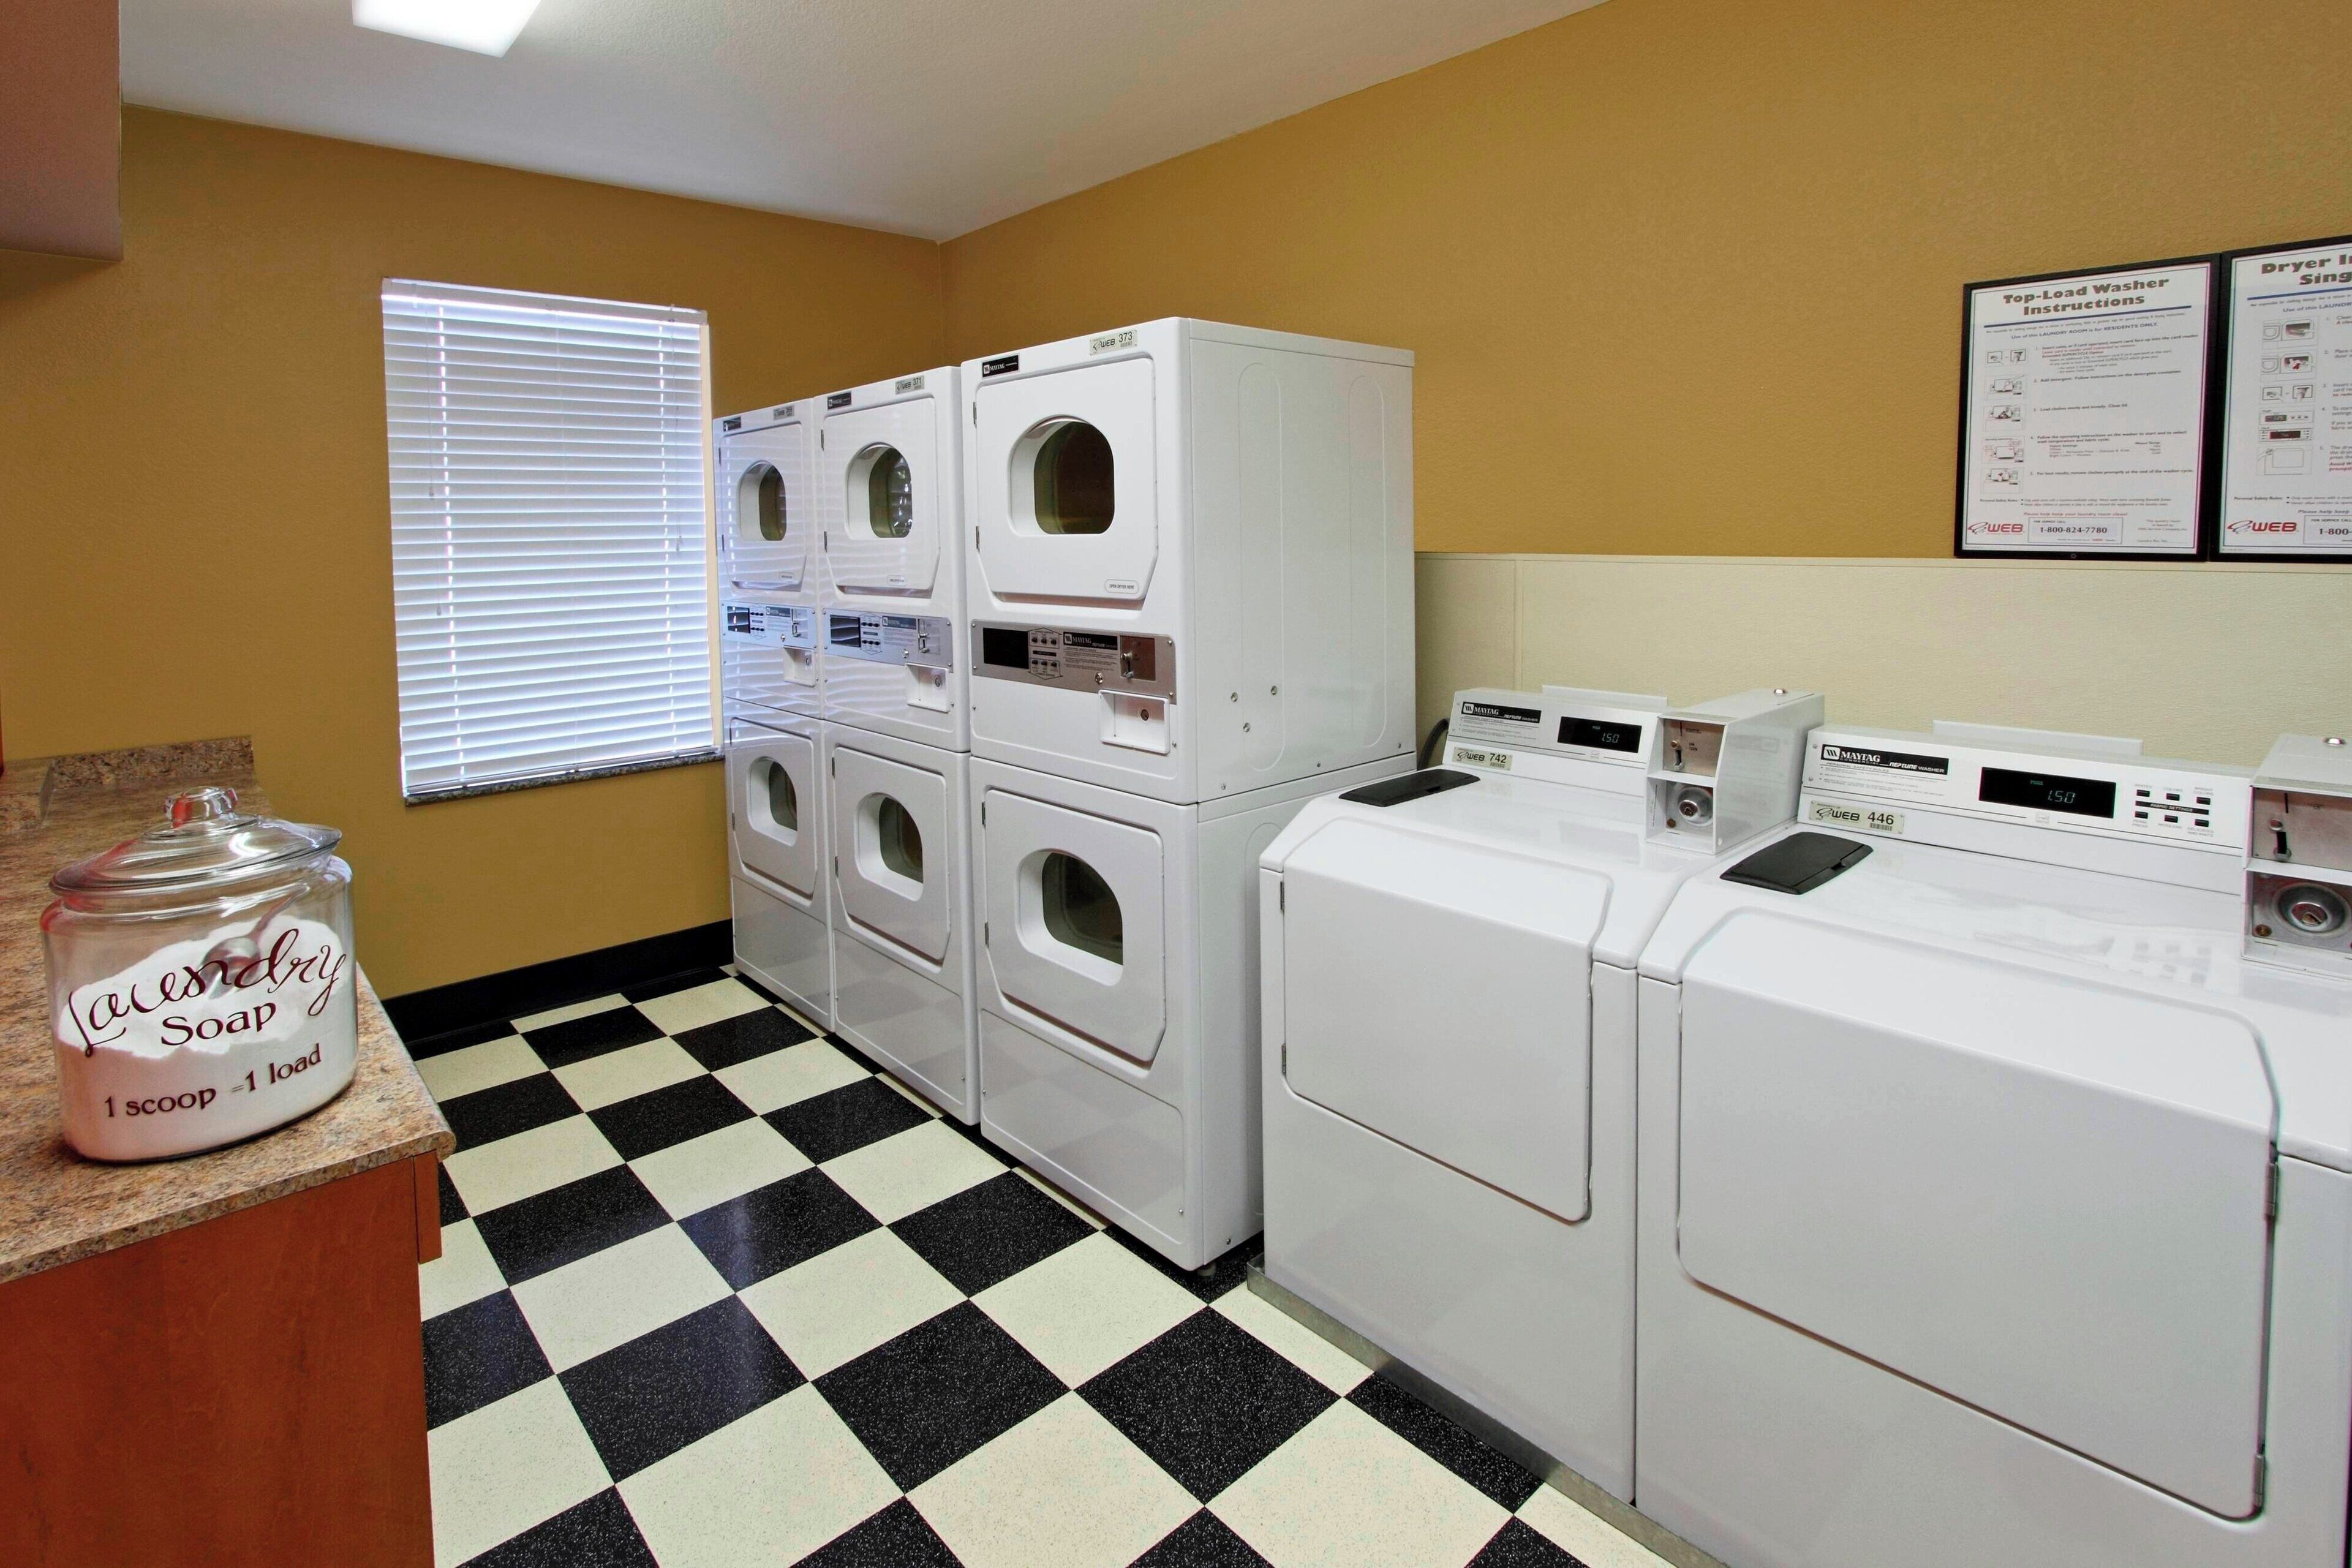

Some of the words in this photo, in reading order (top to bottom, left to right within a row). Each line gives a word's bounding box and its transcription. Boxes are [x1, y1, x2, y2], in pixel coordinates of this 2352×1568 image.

[2261, 258, 2331, 274] Dryer
[2299, 271, 2352, 285] Sing
[2003, 286, 2087, 304] Top-Load
[2093, 278, 2169, 294] Washer
[2024, 295, 2145, 315] Instructions
[1100, 338, 1115, 348] WEB
[1118, 331, 1133, 343] 373
[913, 377, 922, 386] 371
[1987, 524, 2024, 533] WEB
[2252, 522, 2297, 532] WEB
[1474, 707, 1499, 715] MAYTAG
[1467, 752, 1485, 761] WEB
[1490, 753, 1507, 763] 742
[1841, 751, 1880, 763] MAYTAG
[1831, 810, 1860, 821] WEB
[1868, 812, 1894, 825] 446
[69, 928, 347, 1058] Laundry
[161, 1001, 276, 1046] Soap
[105, 1096, 115, 1117] 1
[126, 1087, 216, 1116] scoop
[270, 1042, 322, 1084] load
